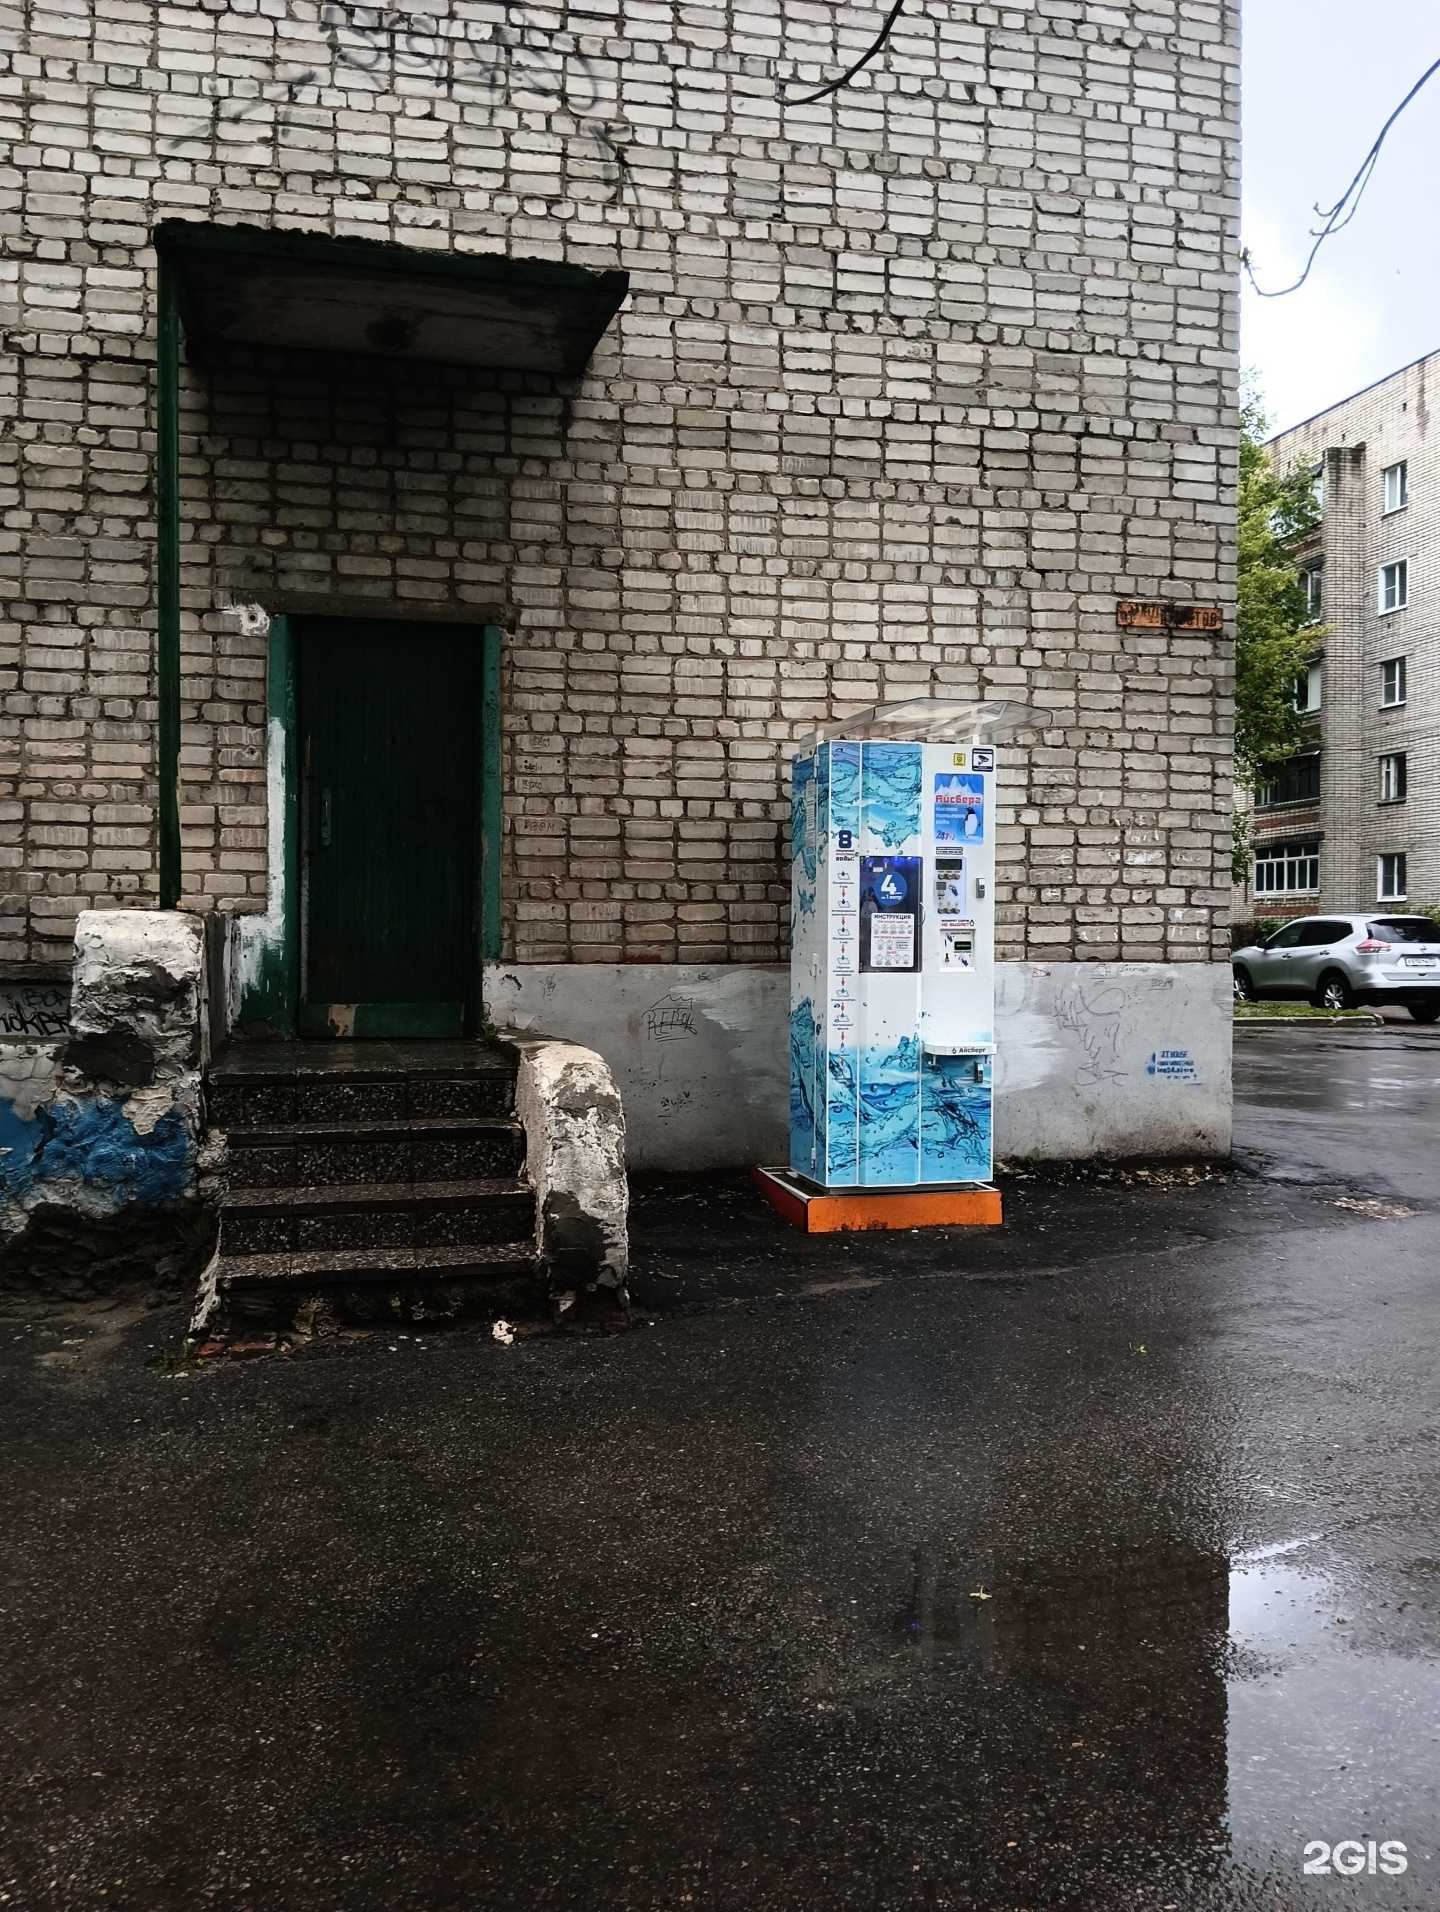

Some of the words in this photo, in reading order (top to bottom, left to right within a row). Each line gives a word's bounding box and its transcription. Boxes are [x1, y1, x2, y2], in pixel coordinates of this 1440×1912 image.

[935, 794, 981, 806] Айсберг
[838, 829, 852, 849] 8
[881, 874, 897, 895] 4
